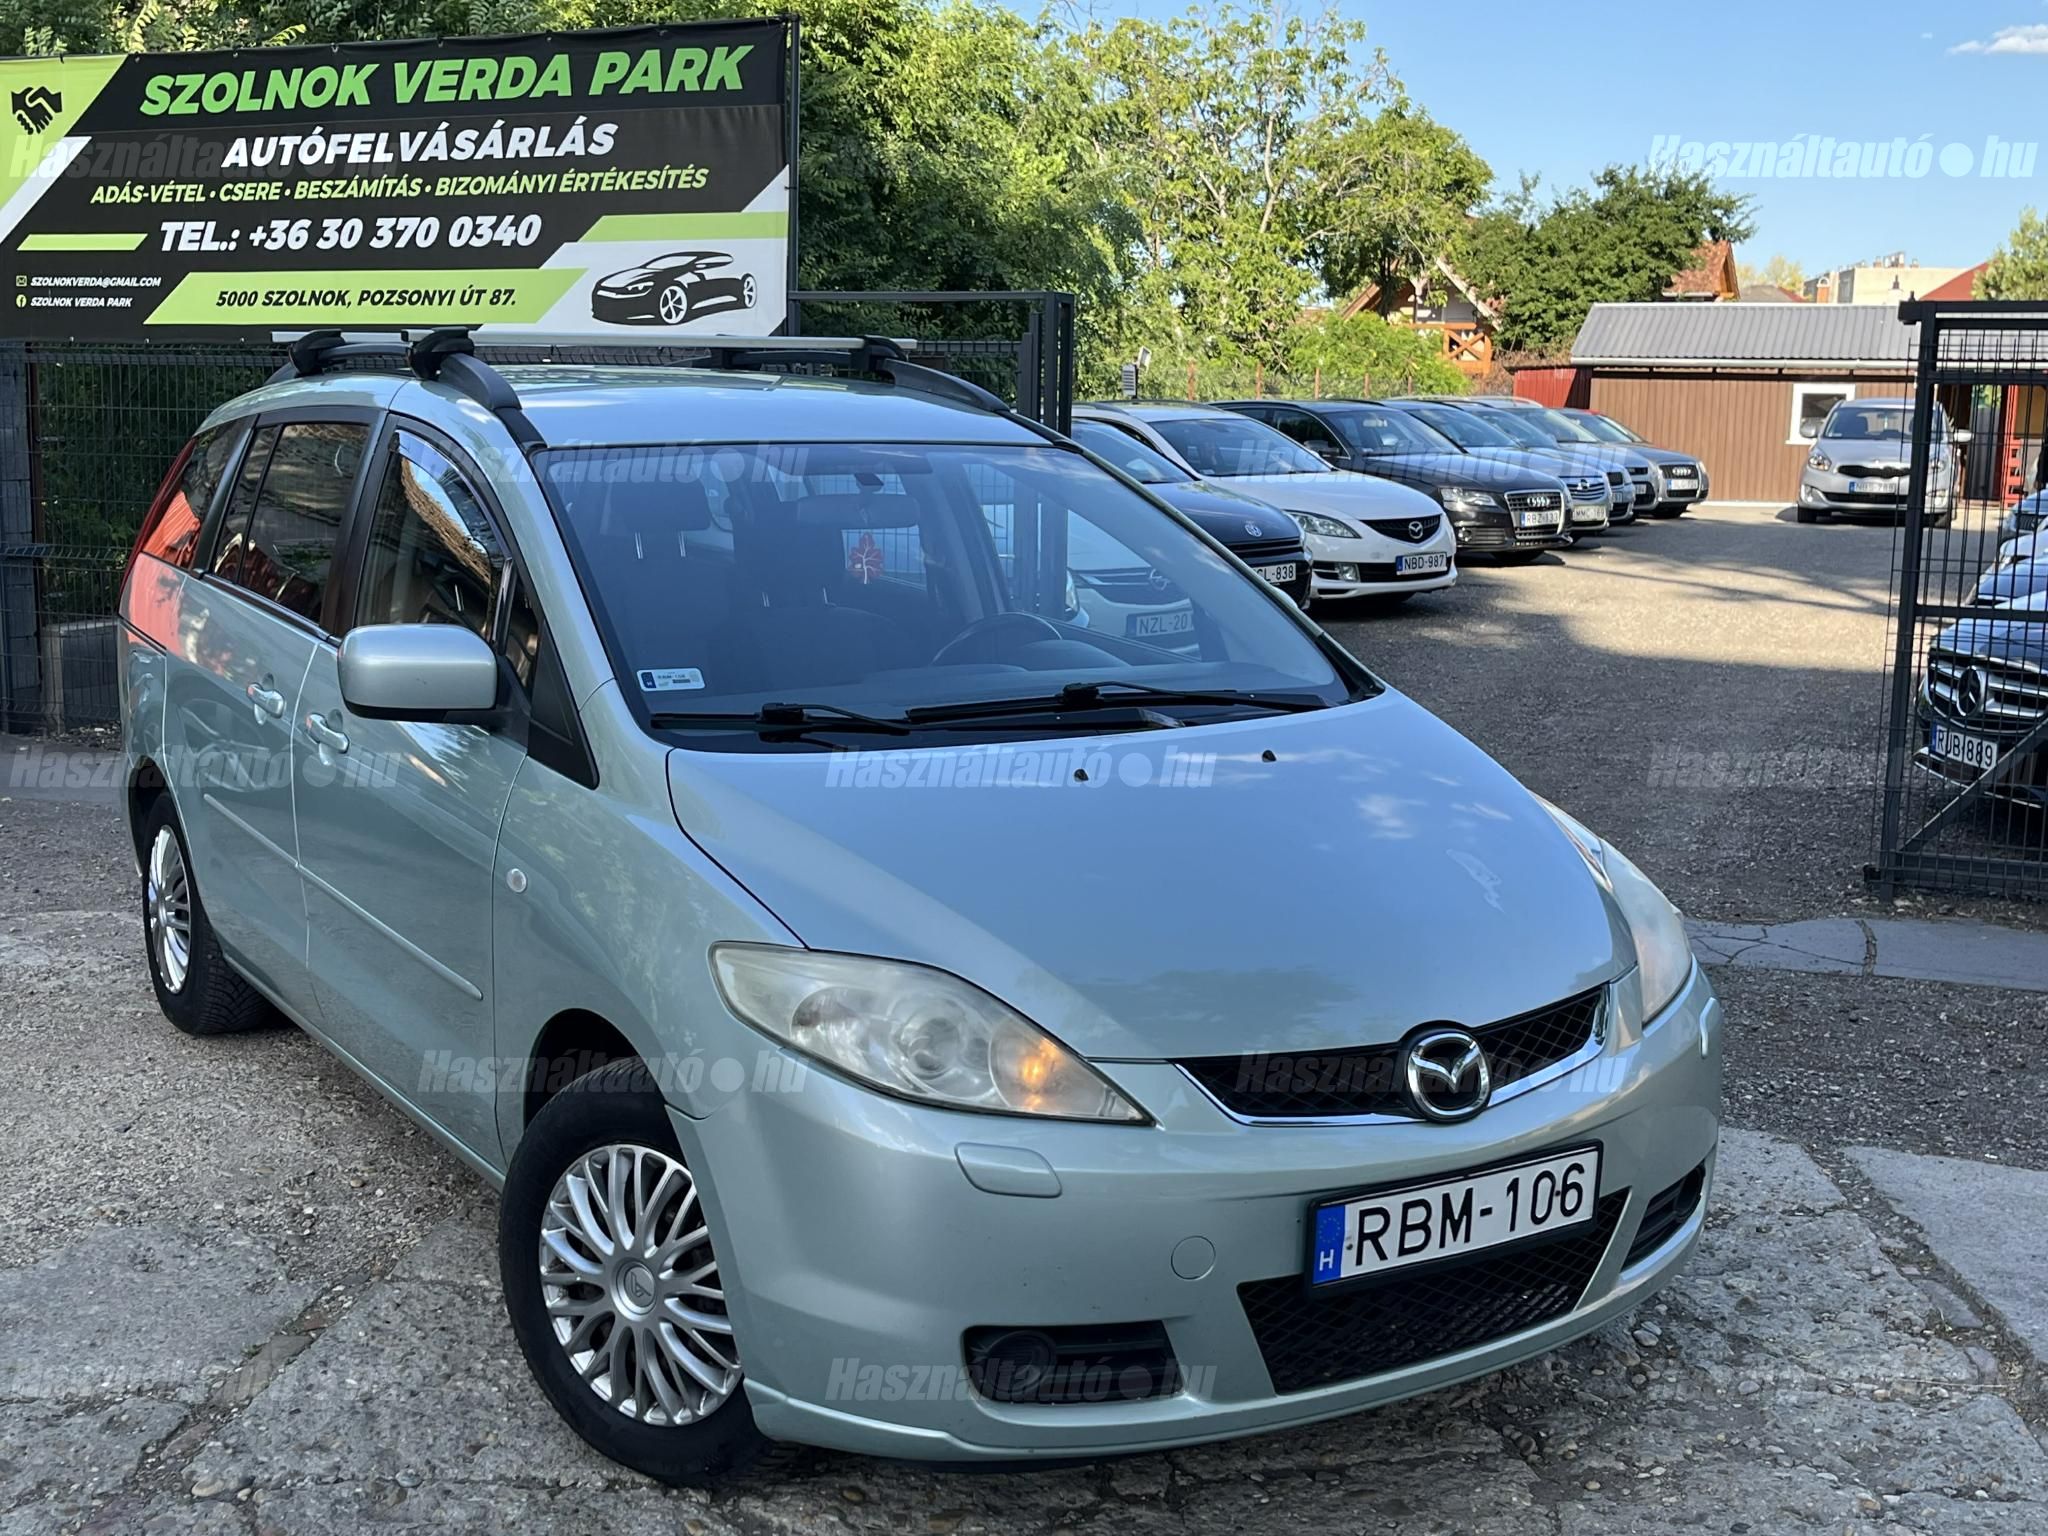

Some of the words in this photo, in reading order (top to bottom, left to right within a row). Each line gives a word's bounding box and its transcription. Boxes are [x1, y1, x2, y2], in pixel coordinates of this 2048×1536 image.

[140, 63, 379, 115] SZOLNOK
[393, 53, 572, 103] VERDA
[589, 44, 753, 96] PARK
[221, 115, 619, 168] AUTÓFELVÁSÁRLÁS
[90, 181, 206, 204] ADÁS-VÉTEL
[219, 181, 283, 201] CSERE
[294, 174, 422, 199] BESZÁMÍTÁS
[435, 170, 561, 196] BIZOMÁNYI
[559, 164, 709, 193] ÉRTÉKESÍTÉS
[159, 221, 241, 251] TEL.:
[249, 219, 312, 250] +36
[316, 218, 364, 249] 30
[369, 217, 440, 249] 370
[448, 214, 543, 248] 0340
[30, 277, 161, 287] SZOLNOKVERDA@GMAIL.COM
[215, 290, 258, 307] 5000
[261, 289, 352, 308] SZOLNOK,
[357, 289, 455, 306] POZSONYI
[459, 285, 487, 305] ÚT
[489, 289, 516, 306] 87.
[30, 297, 72, 307] SZOLNOK
[75, 298, 105, 307] VERDA
[106, 298, 132, 307] PARK
[1401, 553, 1446, 574] NBD-987
[1354, 1162, 1586, 1267] RBM-106
